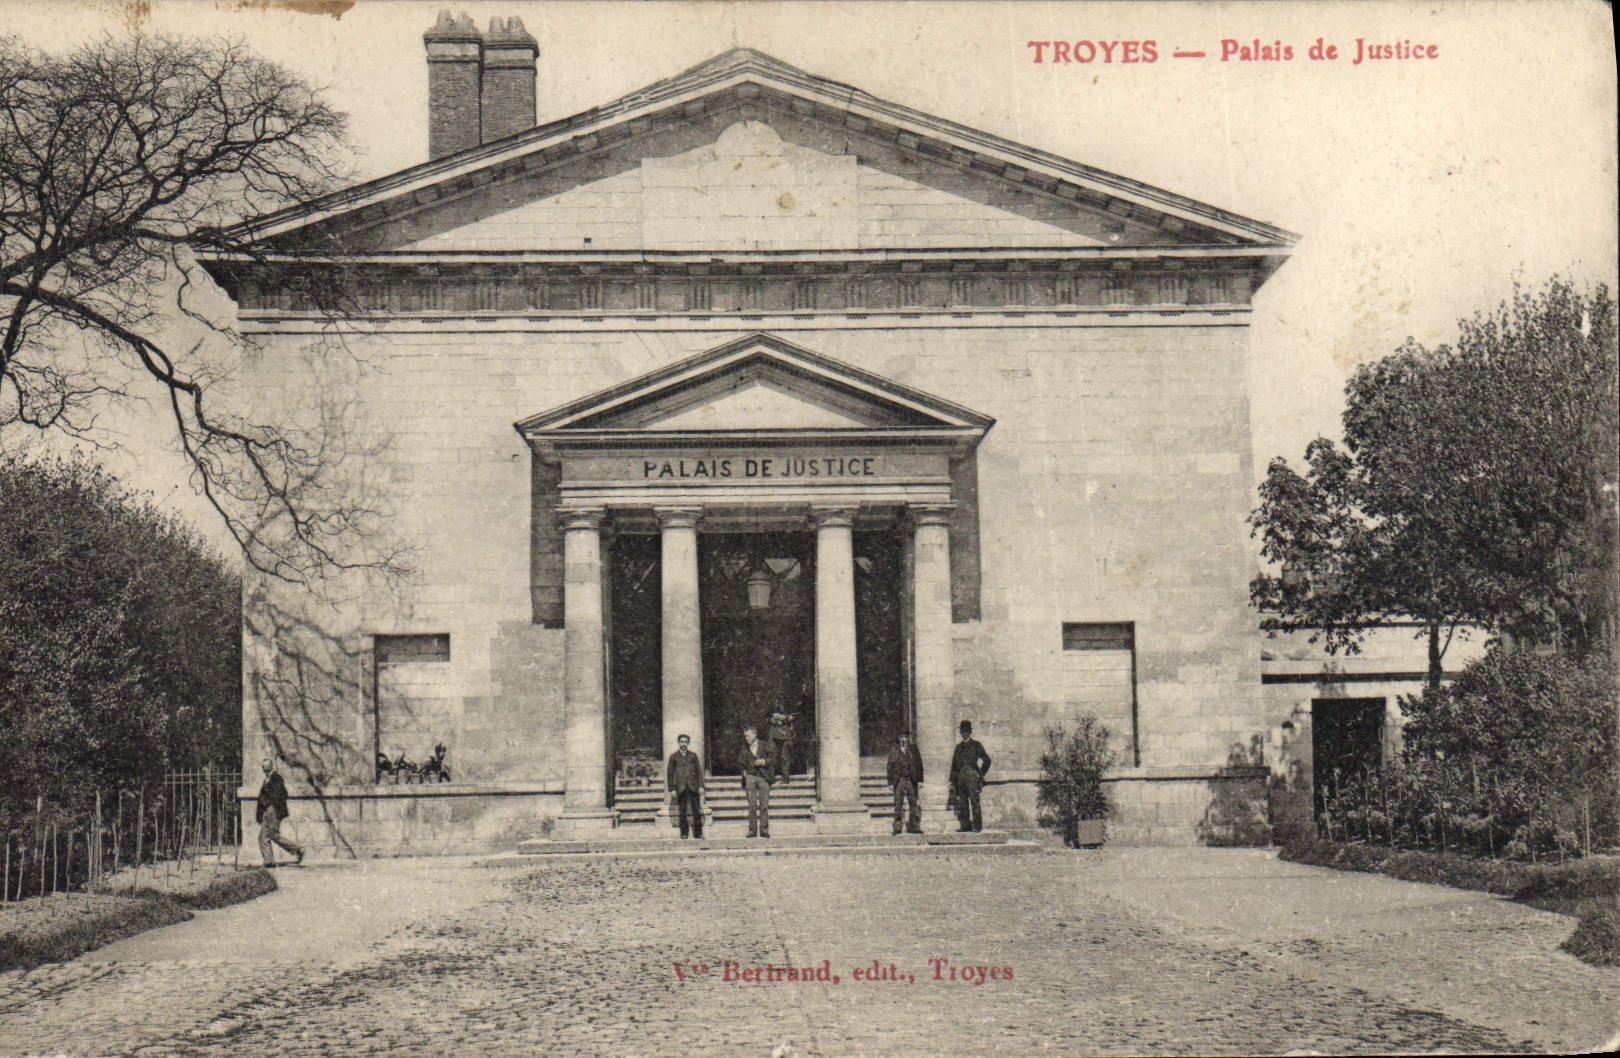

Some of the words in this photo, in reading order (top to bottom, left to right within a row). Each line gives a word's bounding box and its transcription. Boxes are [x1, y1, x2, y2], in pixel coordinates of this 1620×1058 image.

[643, 460, 733, 478] PALAIS
[745, 459, 773, 477] DE
[781, 457, 875, 477] JUSTICE
